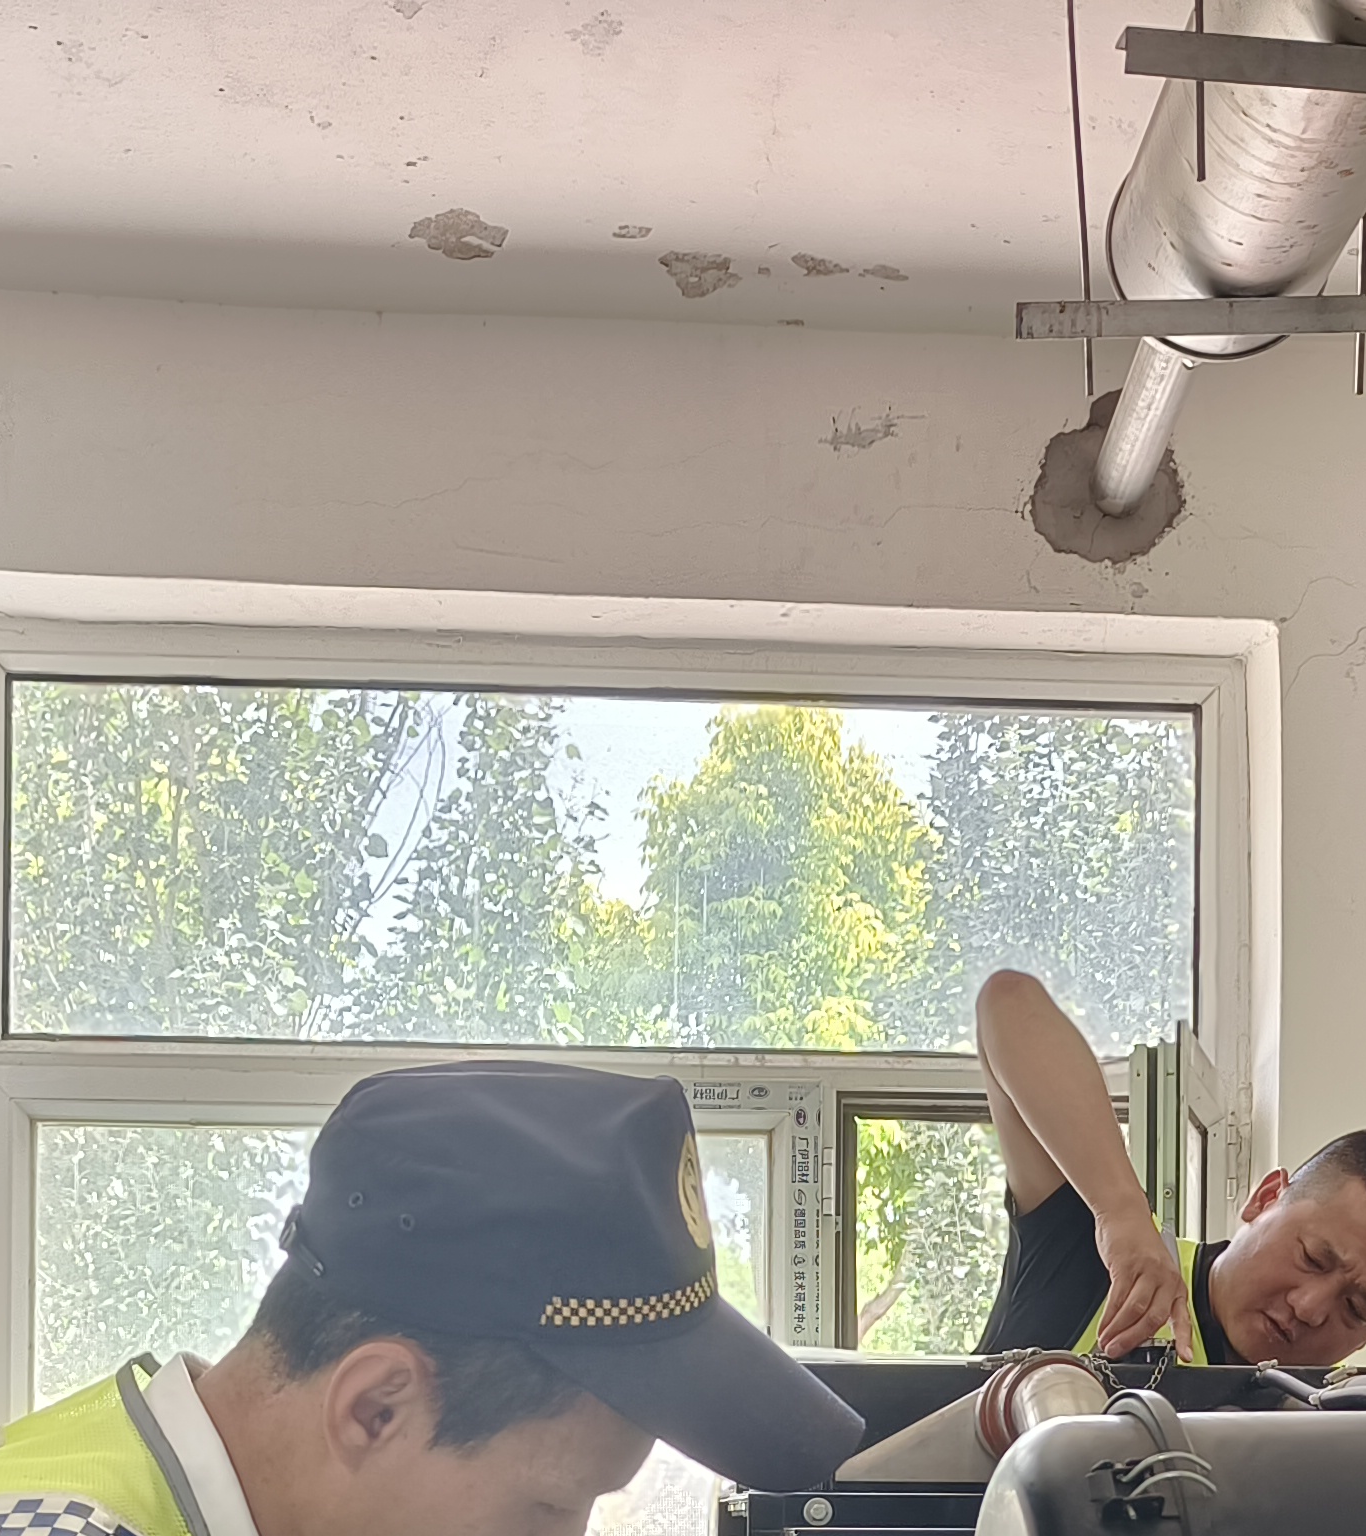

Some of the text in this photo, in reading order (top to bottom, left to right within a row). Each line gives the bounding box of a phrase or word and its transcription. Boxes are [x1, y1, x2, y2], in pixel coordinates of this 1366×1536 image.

[797, 1136, 810, 1184] 广伊铝材
[793, 1208, 806, 1334] 德国品质 技术研发中心
